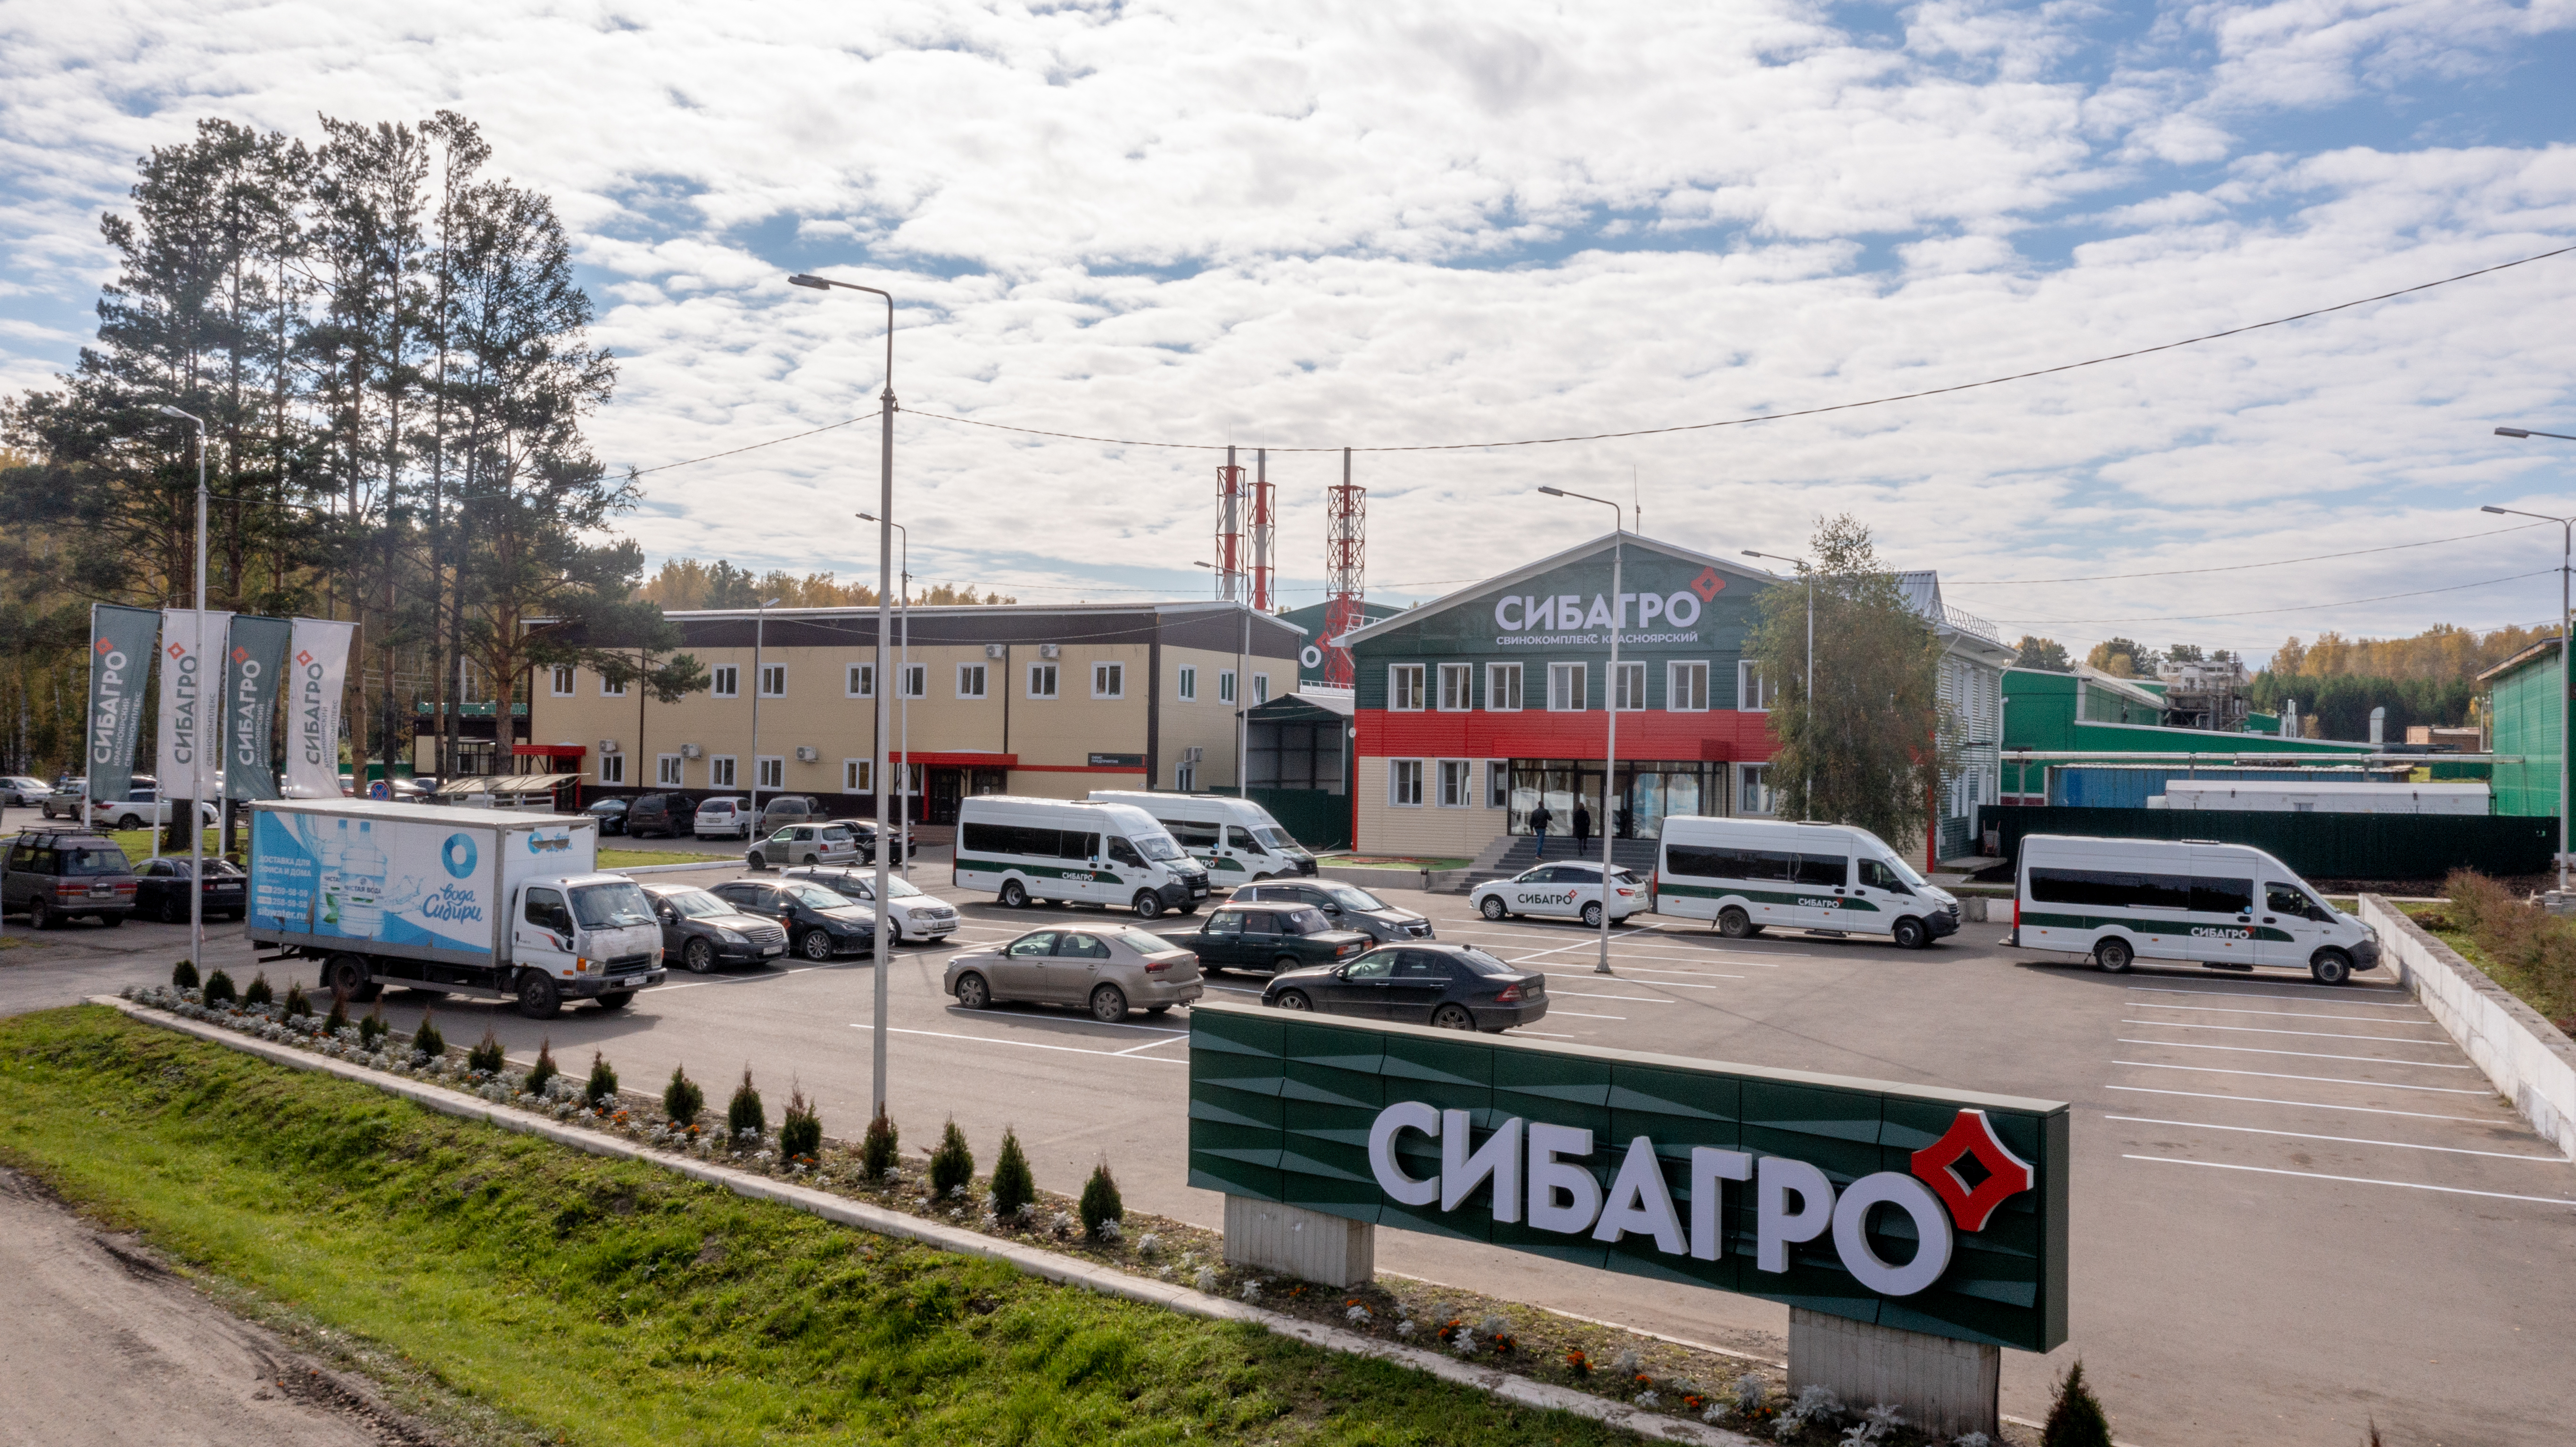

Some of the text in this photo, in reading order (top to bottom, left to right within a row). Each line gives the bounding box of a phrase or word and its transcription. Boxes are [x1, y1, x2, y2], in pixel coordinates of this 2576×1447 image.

[1495, 591, 1701, 631] СИБАГРО
[1496, 634, 1598, 645] СВИНОКОМПЛЕКС
[94, 651, 127, 764] СИБАГРО
[113, 698, 130, 766] КРАСНОЯРСКИЙ
[124, 691, 142, 767] СВИНОКОМПЛЕКС
[174, 656, 197, 764] СИБАГРО
[206, 693, 216, 766] СВИНОКОМПЛЕКС
[238, 660, 261, 765] СИБАГРО
[304, 663, 324, 765] СИБАГРО
[1062, 871, 1094, 881] СИБАГРО
[1518, 894, 1572, 904] СИБАГРО
[1798, 897, 1840, 908] СИБАГРО
[2191, 927, 2249, 939] СИБАГРО
[1369, 1101, 1953, 1296] СИБАГРО
